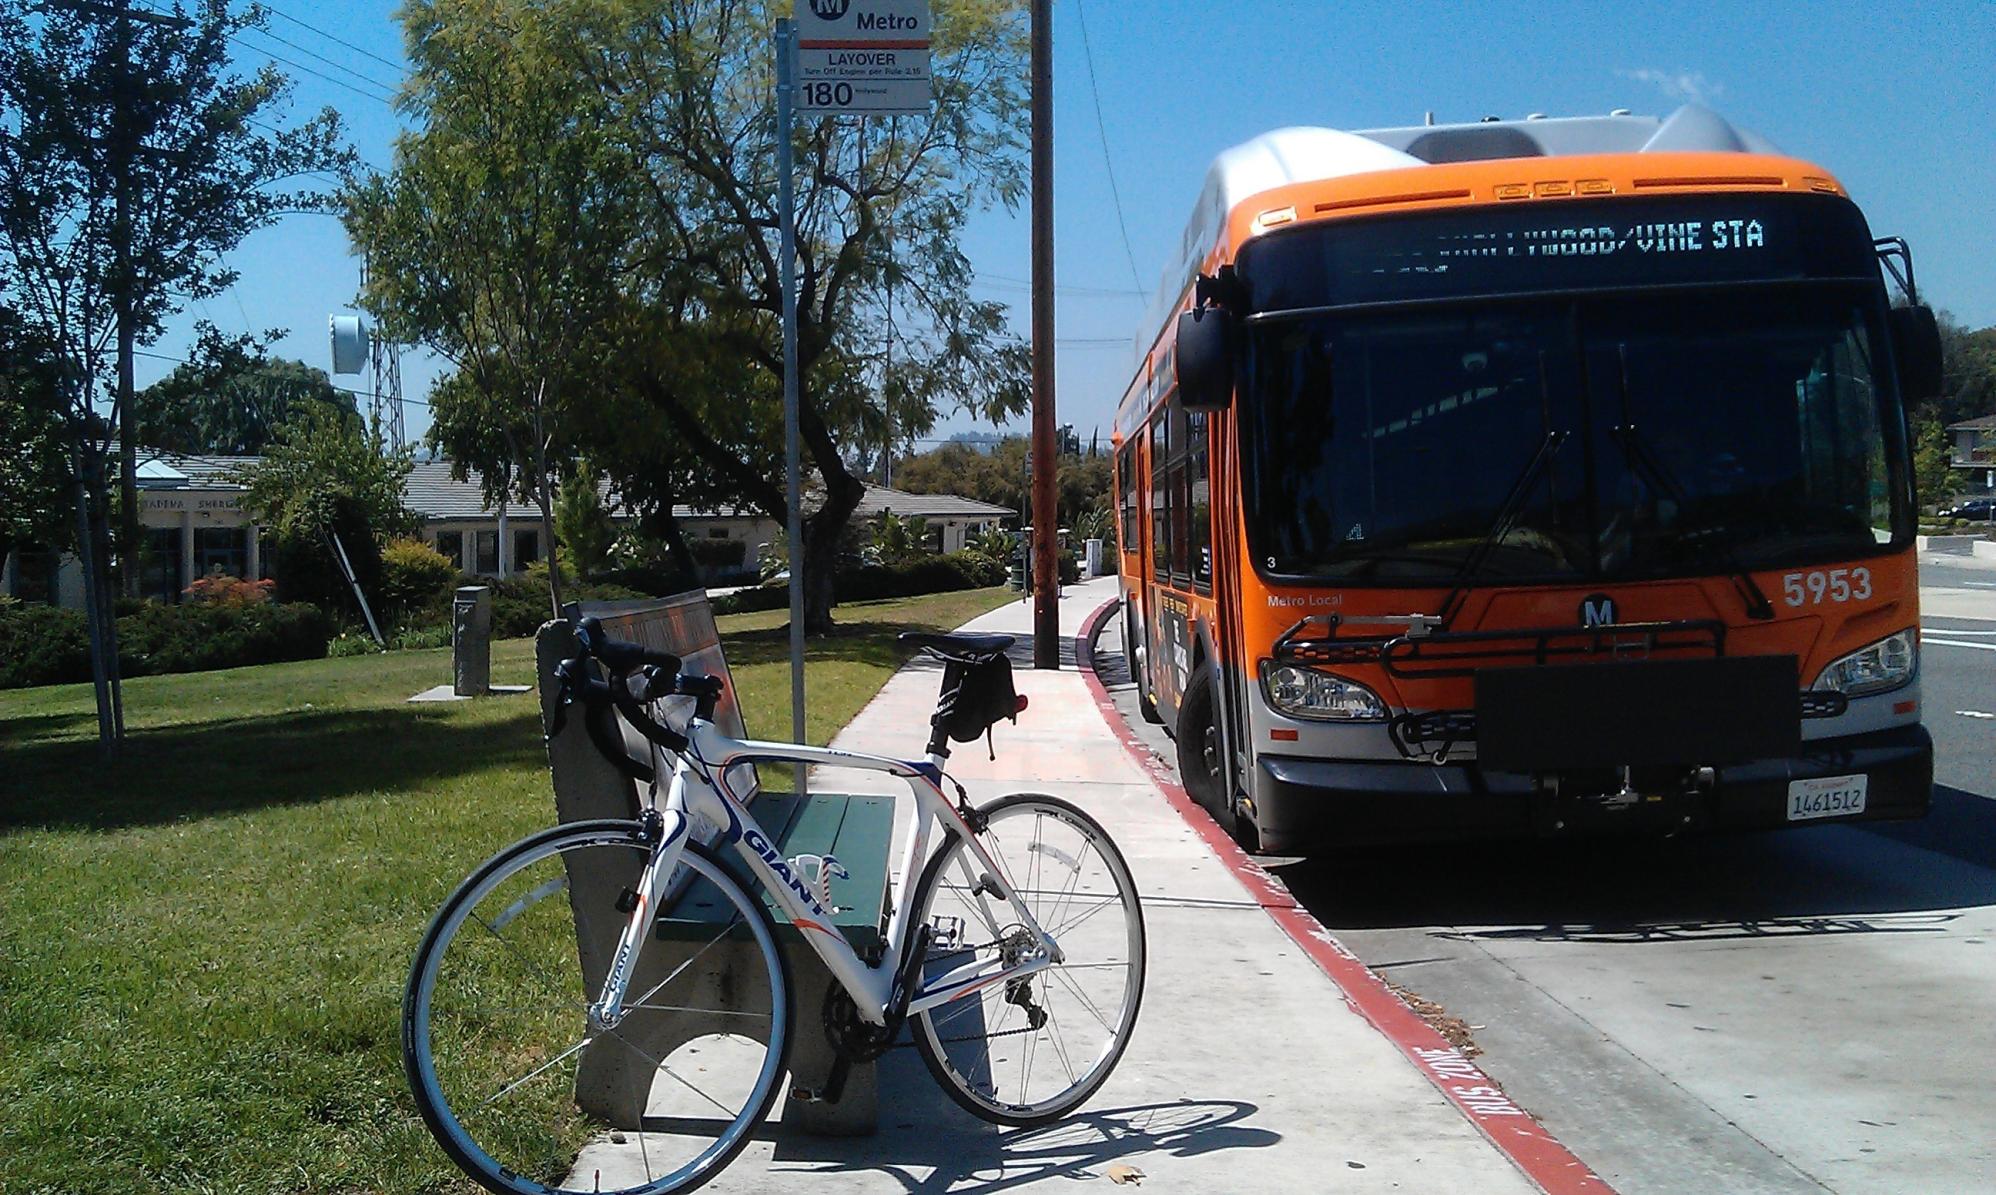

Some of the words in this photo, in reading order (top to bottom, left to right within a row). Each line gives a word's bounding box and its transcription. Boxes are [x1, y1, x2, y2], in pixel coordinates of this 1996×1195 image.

[856, 12, 918, 30] Metro
[823, 67, 837, 76] Off
[827, 53, 896, 66] LAYOVER
[802, 81, 853, 106] 180
[1712, 219, 1764, 250] STA
[1266, 556, 1277, 569] 3
[1783, 566, 1873, 608] 5953
[1267, 594, 1305, 607] Metro
[1309, 593, 1342, 606] Local
[1793, 789, 1862, 815] 1461512
[743, 829, 824, 916] GIANT
[609, 943, 630, 993] GIANT
